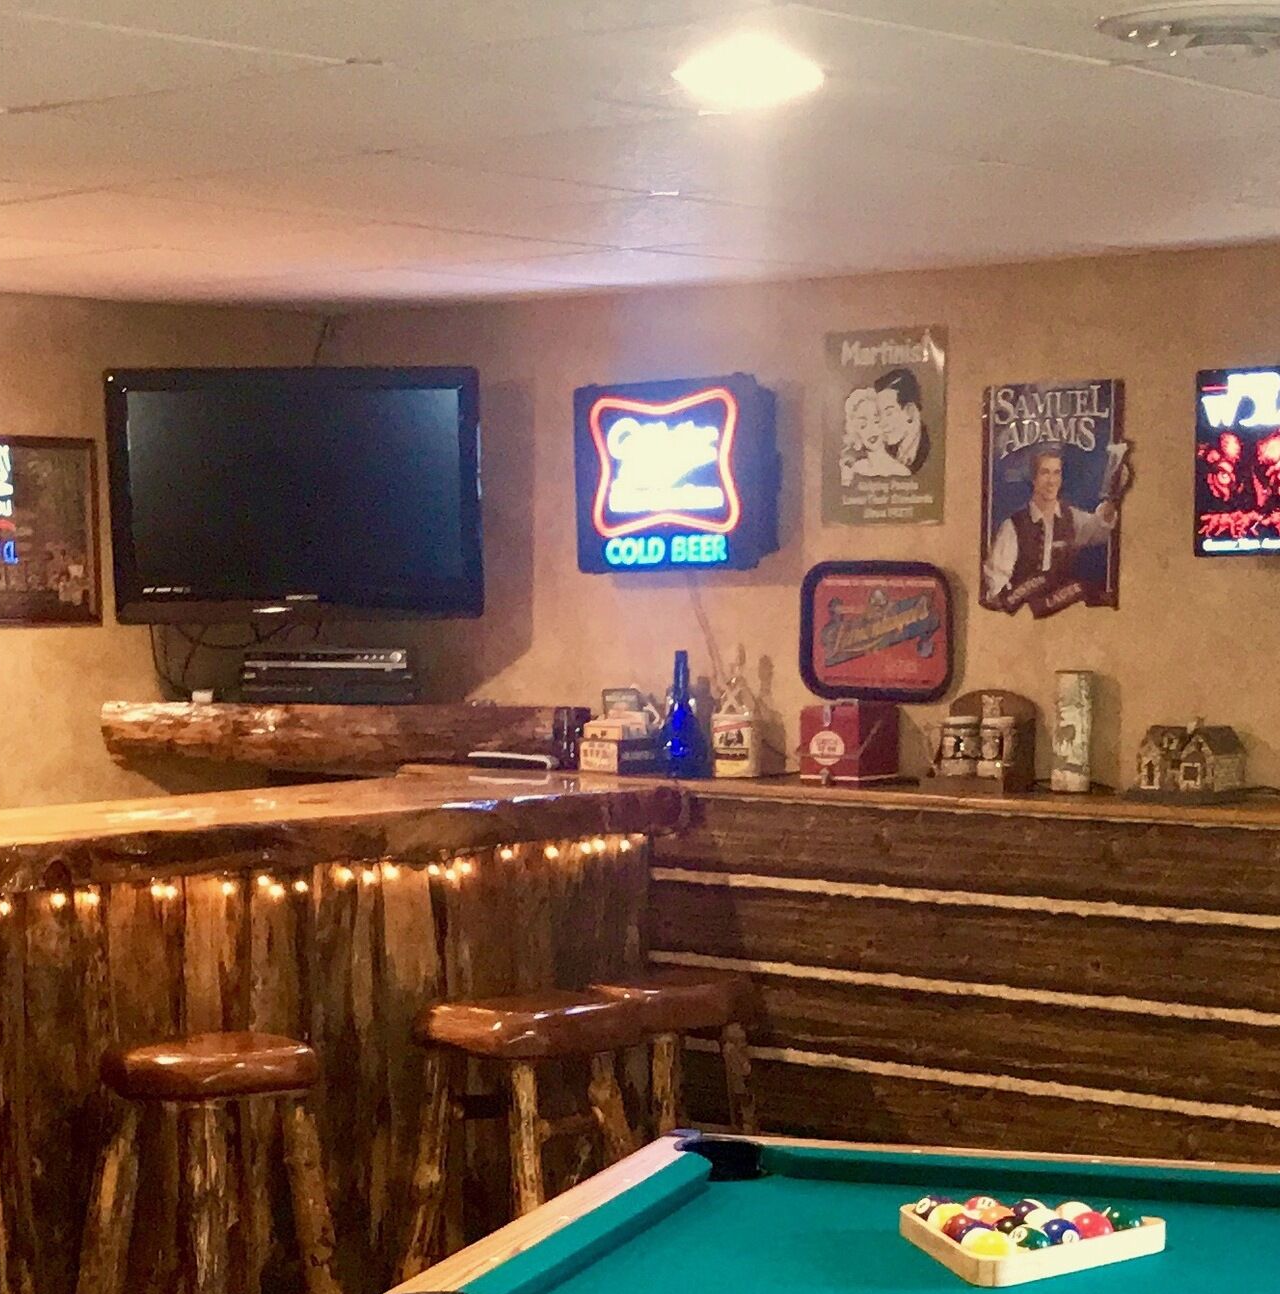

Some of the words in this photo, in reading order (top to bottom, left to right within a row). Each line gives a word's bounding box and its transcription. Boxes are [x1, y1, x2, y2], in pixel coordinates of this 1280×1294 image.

[994, 384, 1110, 425] SAMUEL
[1000, 417, 1096, 459] ADAMS
[605, 535, 666, 565] COLD
[670, 534, 728, 563] BEER
